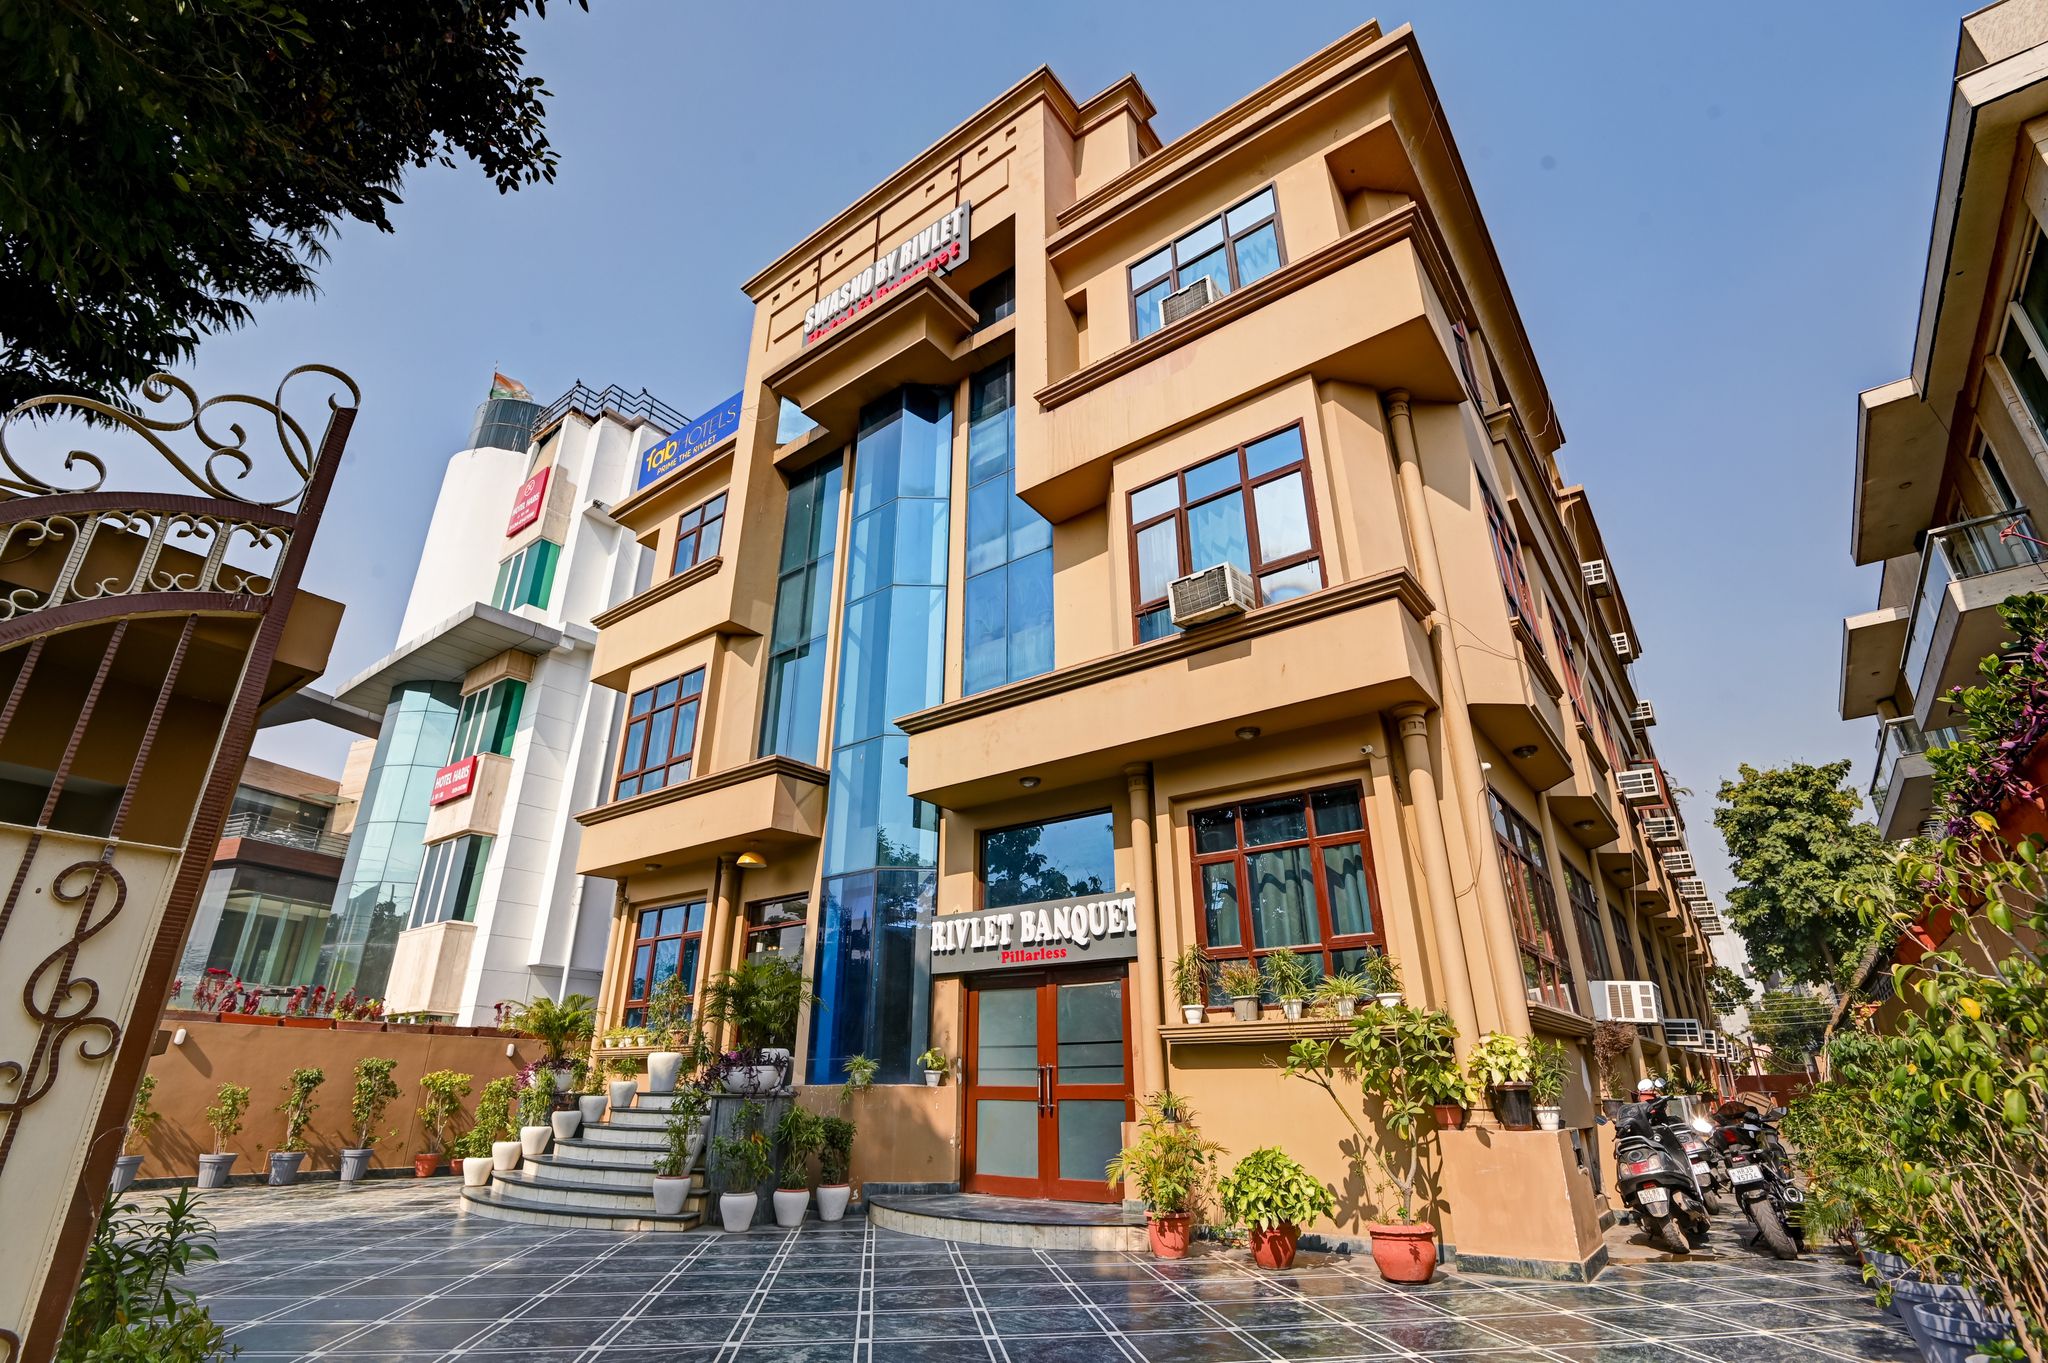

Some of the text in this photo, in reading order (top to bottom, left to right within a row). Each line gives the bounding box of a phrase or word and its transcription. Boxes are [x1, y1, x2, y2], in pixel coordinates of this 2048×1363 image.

[804, 207, 964, 334] SWASNO BY RIVLET
[657, 434, 717, 475] PRIME THE RIVLET
[512, 501, 526, 516] HOTEL
[435, 772, 452, 790] HOTEL
[452, 764, 470, 783] HARIS
[931, 896, 1137, 951] RIVLET BANQUET
[1001, 947, 1067, 964] Pillarless
